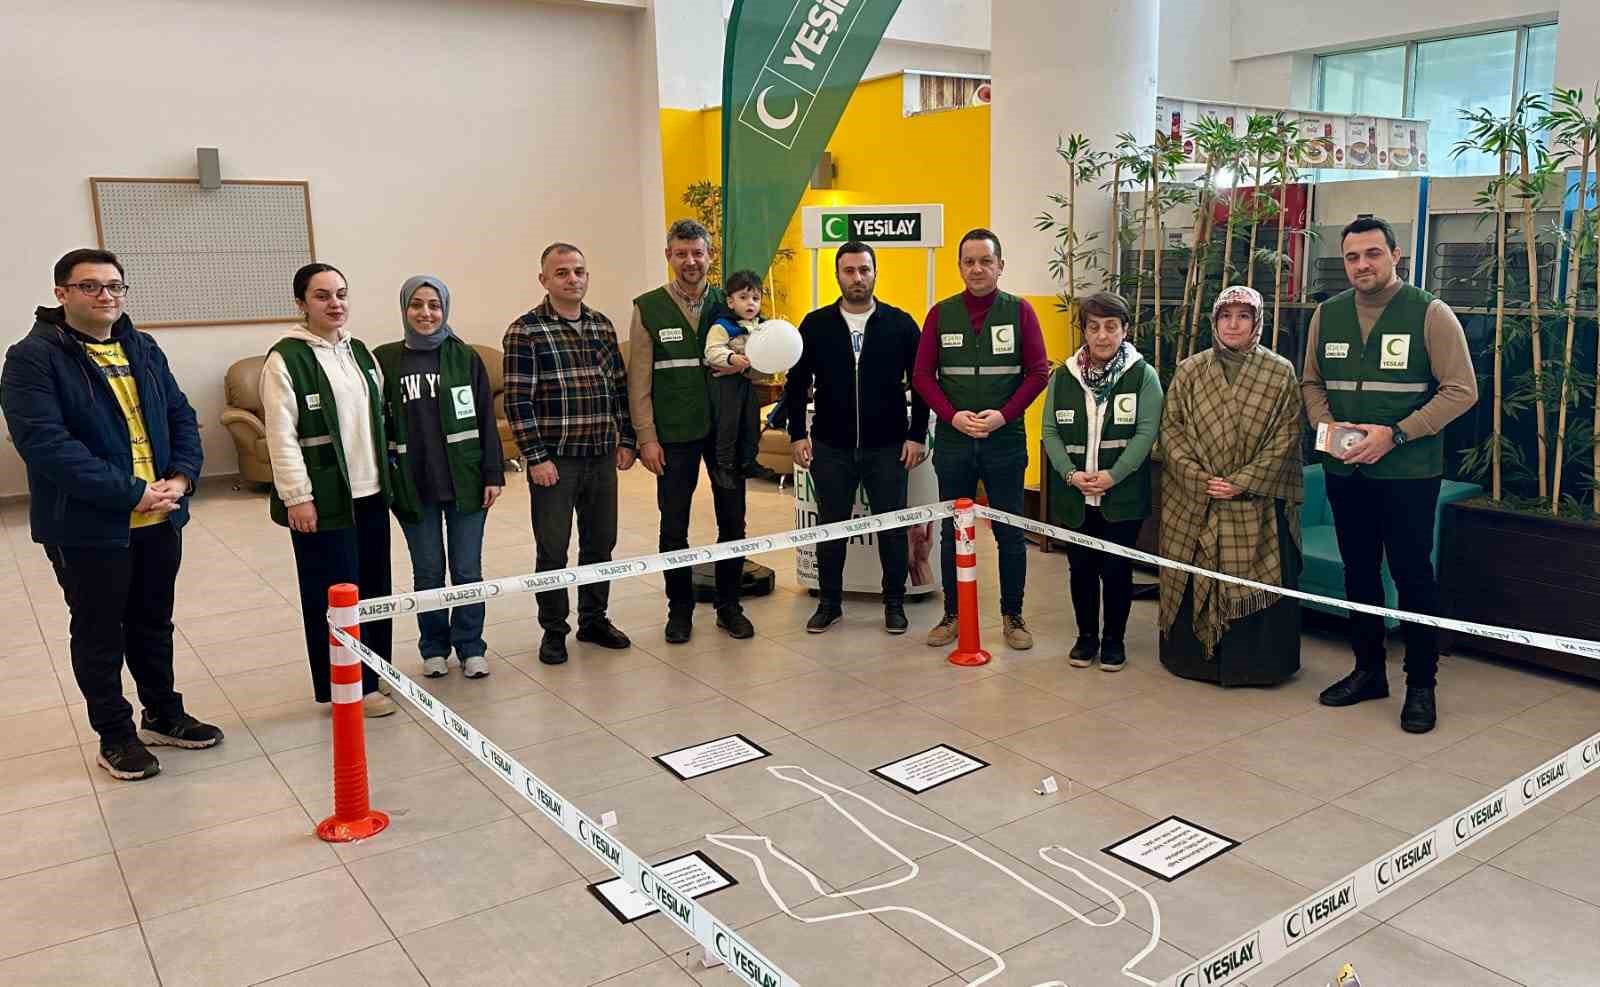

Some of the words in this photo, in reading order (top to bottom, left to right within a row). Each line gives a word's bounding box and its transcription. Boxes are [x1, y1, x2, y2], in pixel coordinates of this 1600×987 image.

[853, 219, 916, 237] YEŞİLAY
[1307, 886, 1351, 925] YEŞİLAY
[1203, 940, 1255, 985] YEŞİLAY
